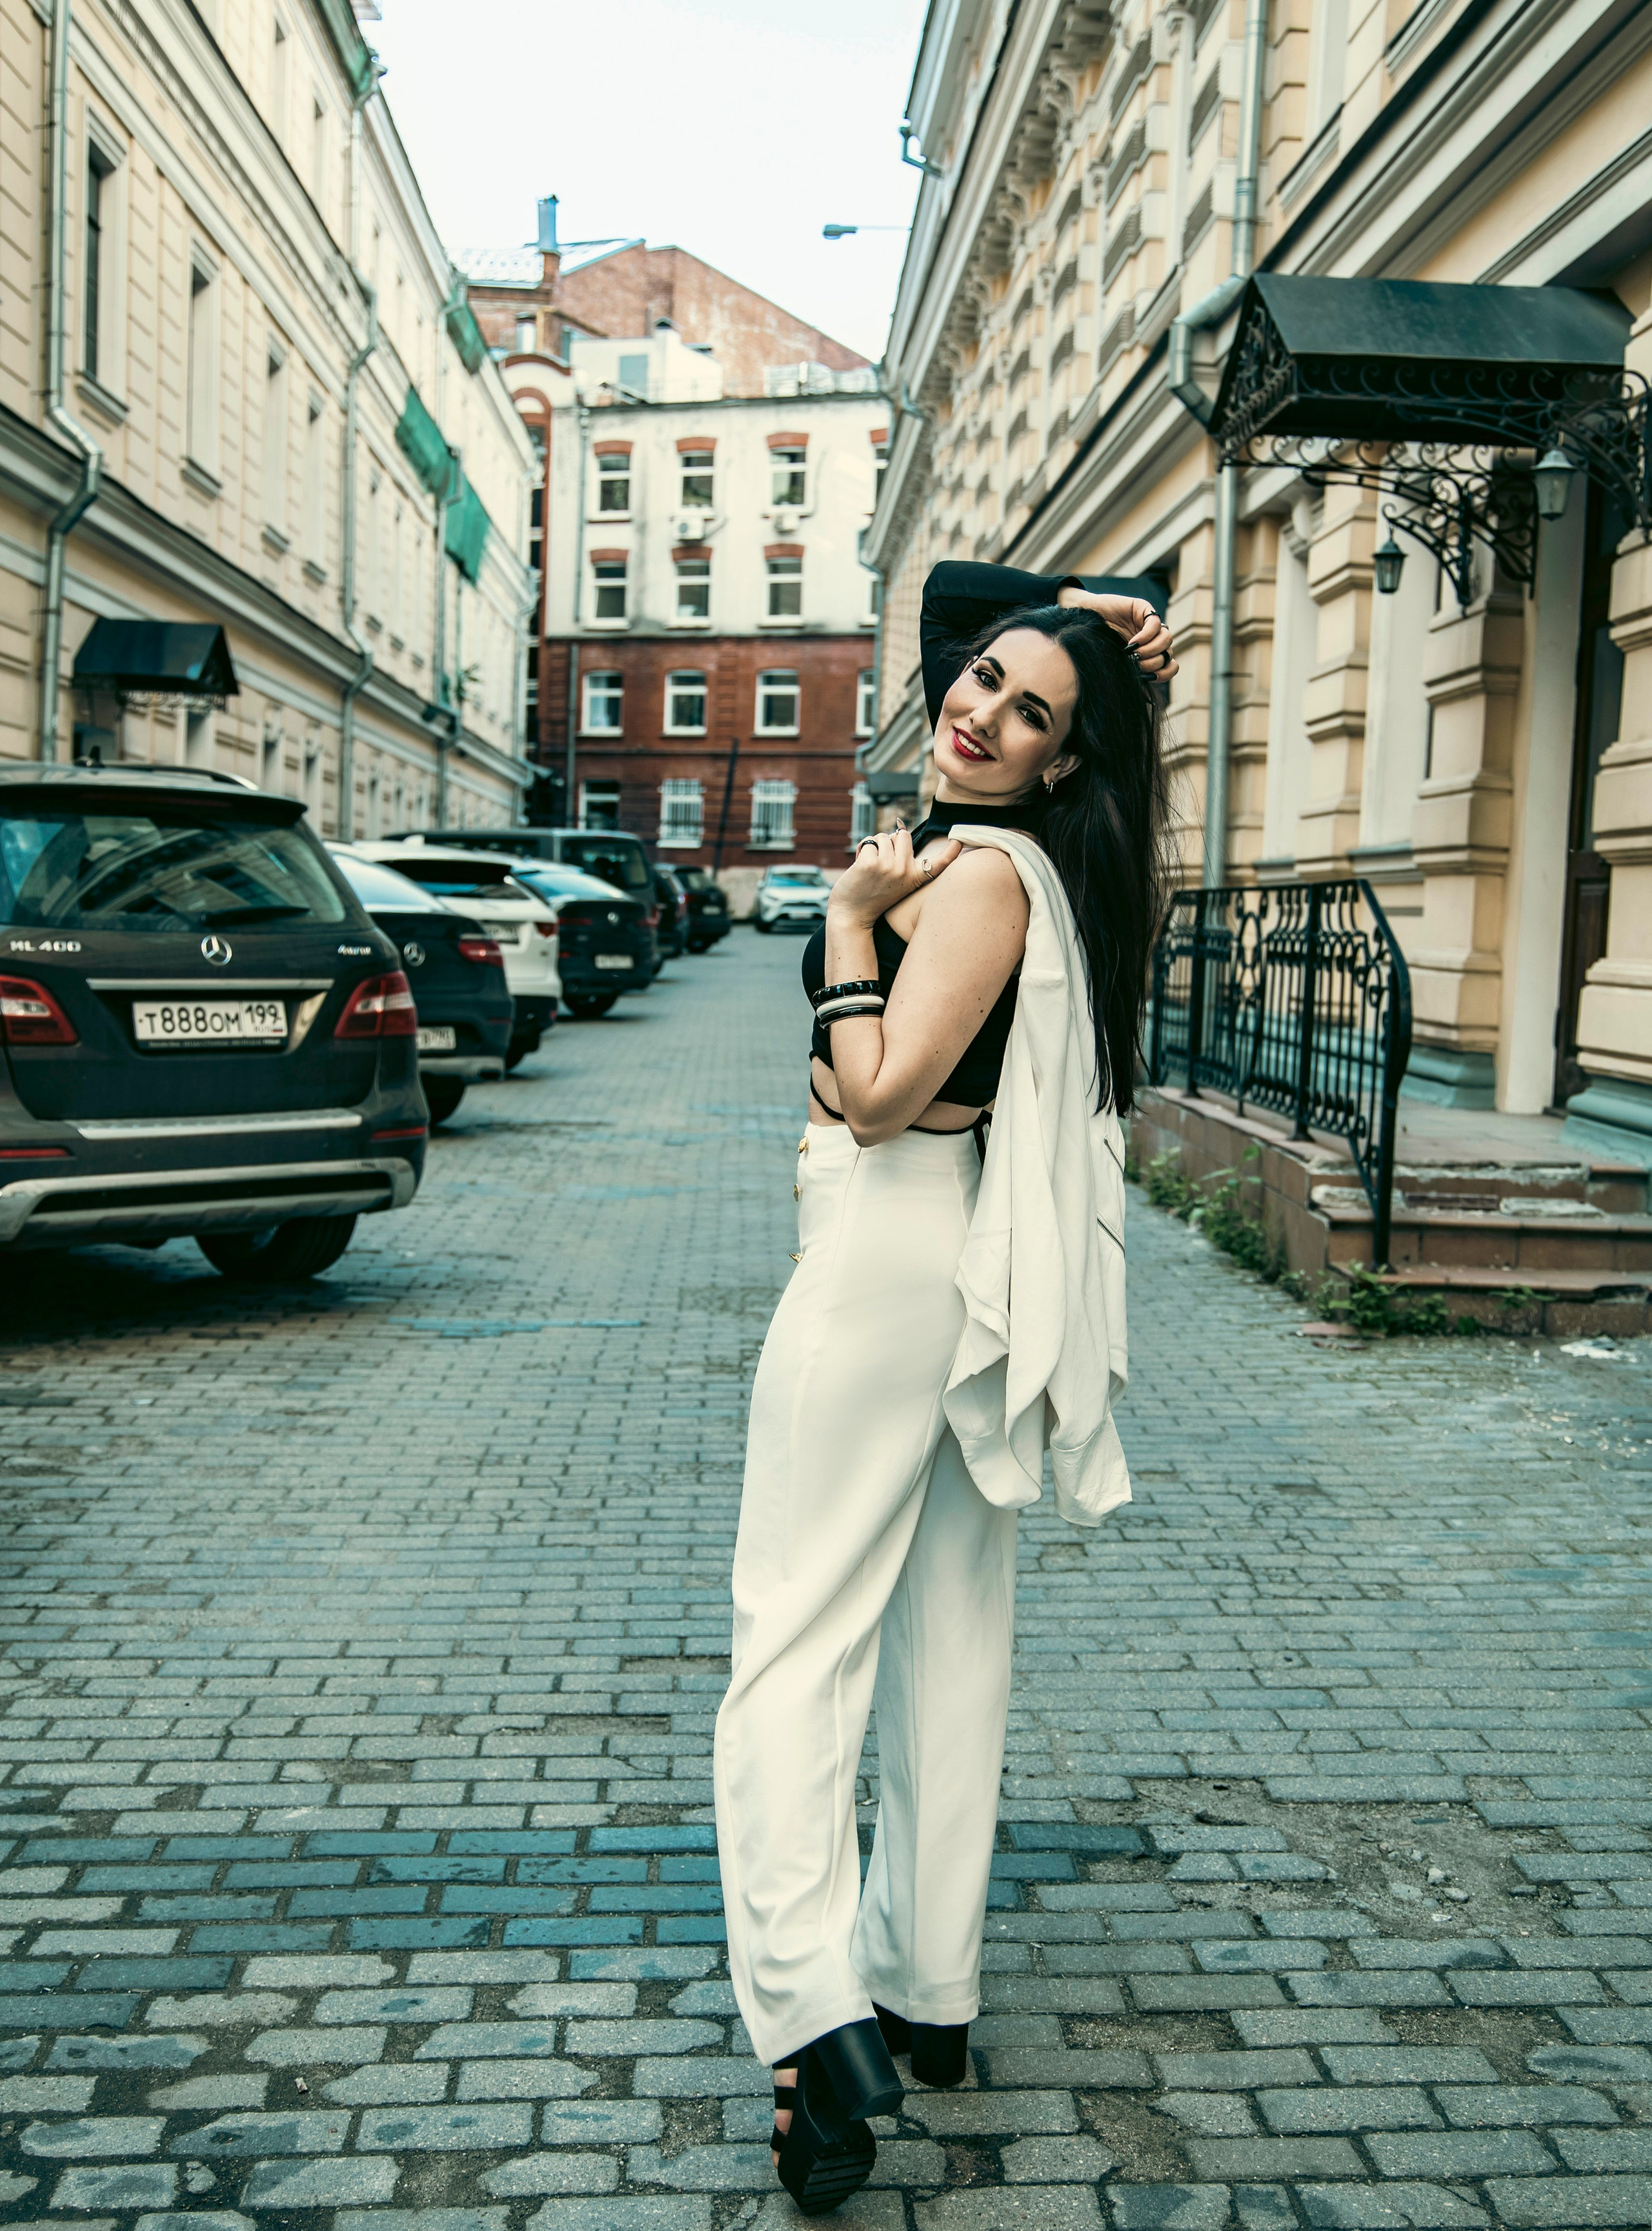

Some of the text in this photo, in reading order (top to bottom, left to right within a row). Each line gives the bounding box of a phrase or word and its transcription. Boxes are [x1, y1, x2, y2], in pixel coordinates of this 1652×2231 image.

[10, 940, 81, 952] ML 400
[245, 1004, 278, 1024] 199
